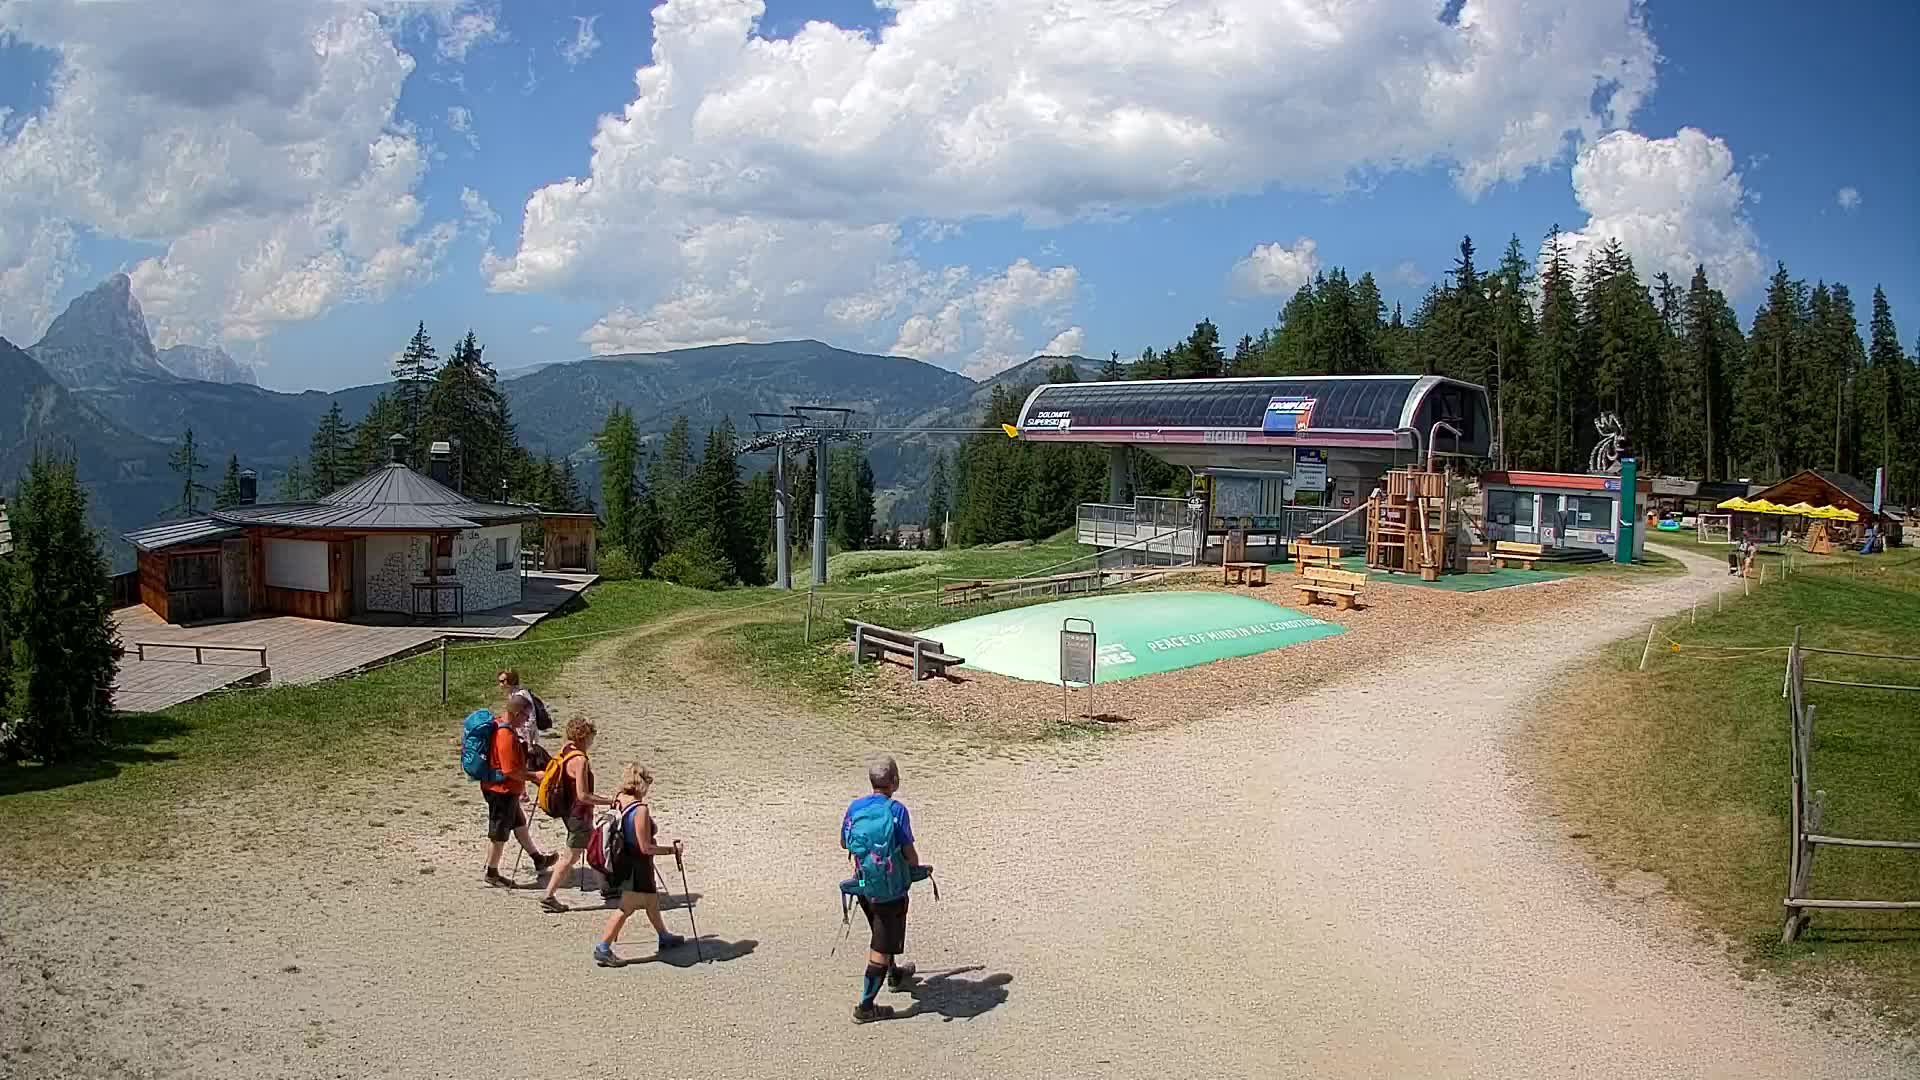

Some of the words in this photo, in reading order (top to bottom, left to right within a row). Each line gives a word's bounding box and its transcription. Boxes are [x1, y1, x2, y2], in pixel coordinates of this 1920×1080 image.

[1147, 636, 1190, 652] PEACE
[1190, 633, 1205, 643] OF
[1206, 629, 1237, 641] MIND
[1238, 627, 1251, 637] IN
[1250, 624, 1271, 634] ALL
